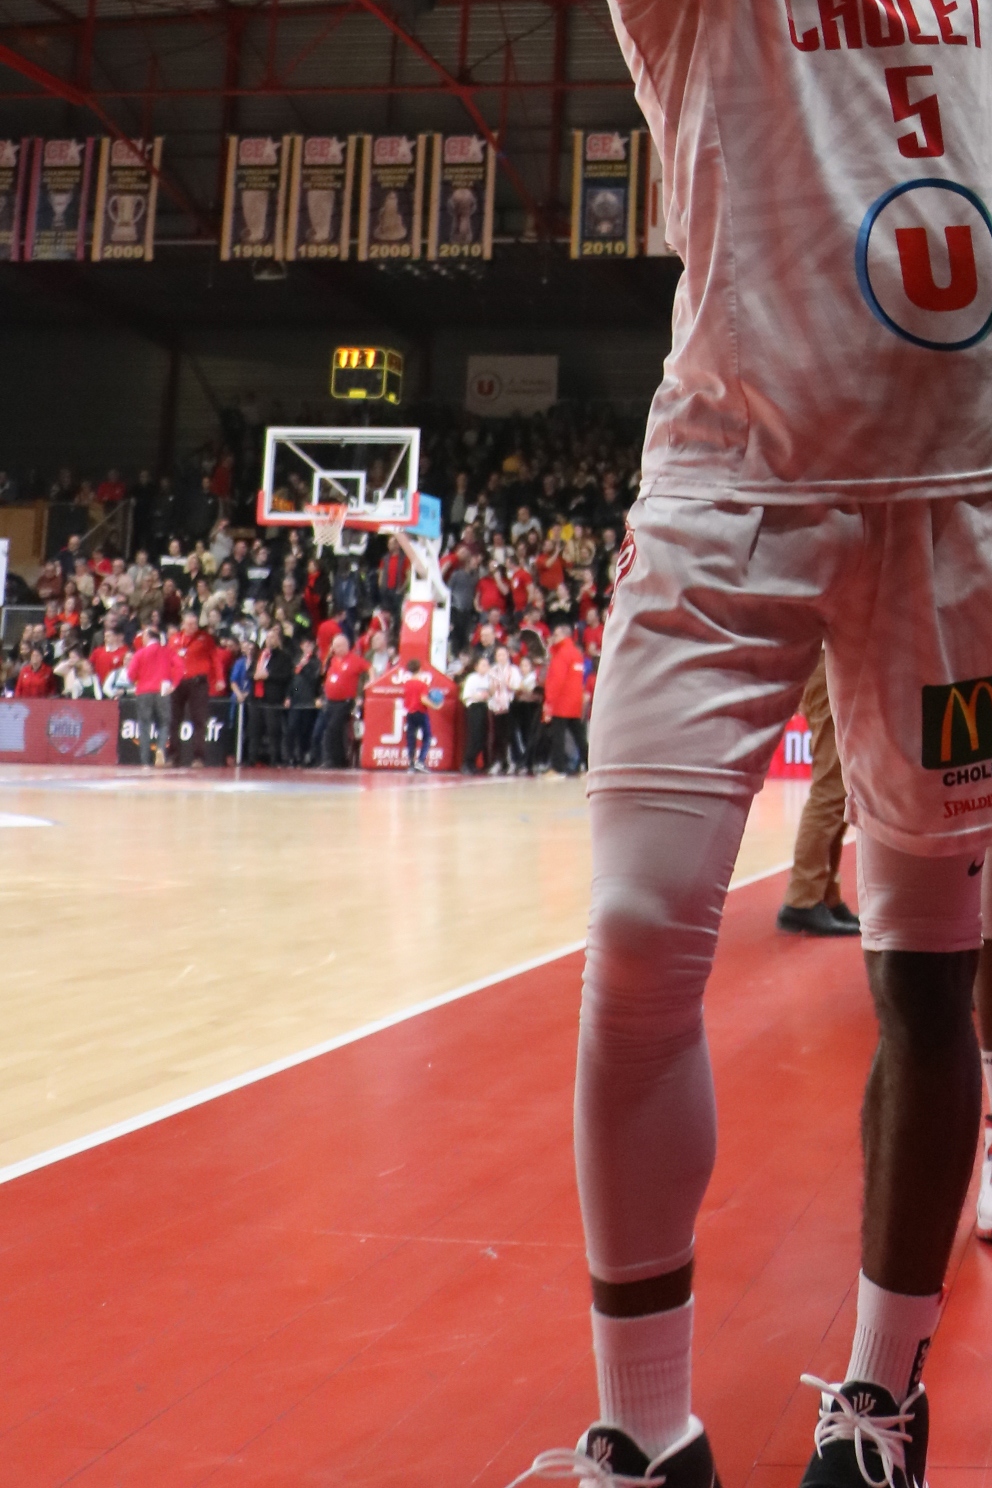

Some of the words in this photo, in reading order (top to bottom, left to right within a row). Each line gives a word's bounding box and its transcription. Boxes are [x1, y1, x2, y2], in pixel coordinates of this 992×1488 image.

[885, 65, 945, 159] 5
[103, 244, 145, 258] 2009
[440, 243, 482, 257] 2010
[582, 240, 626, 255] 2010
[895, 225, 978, 312] U
